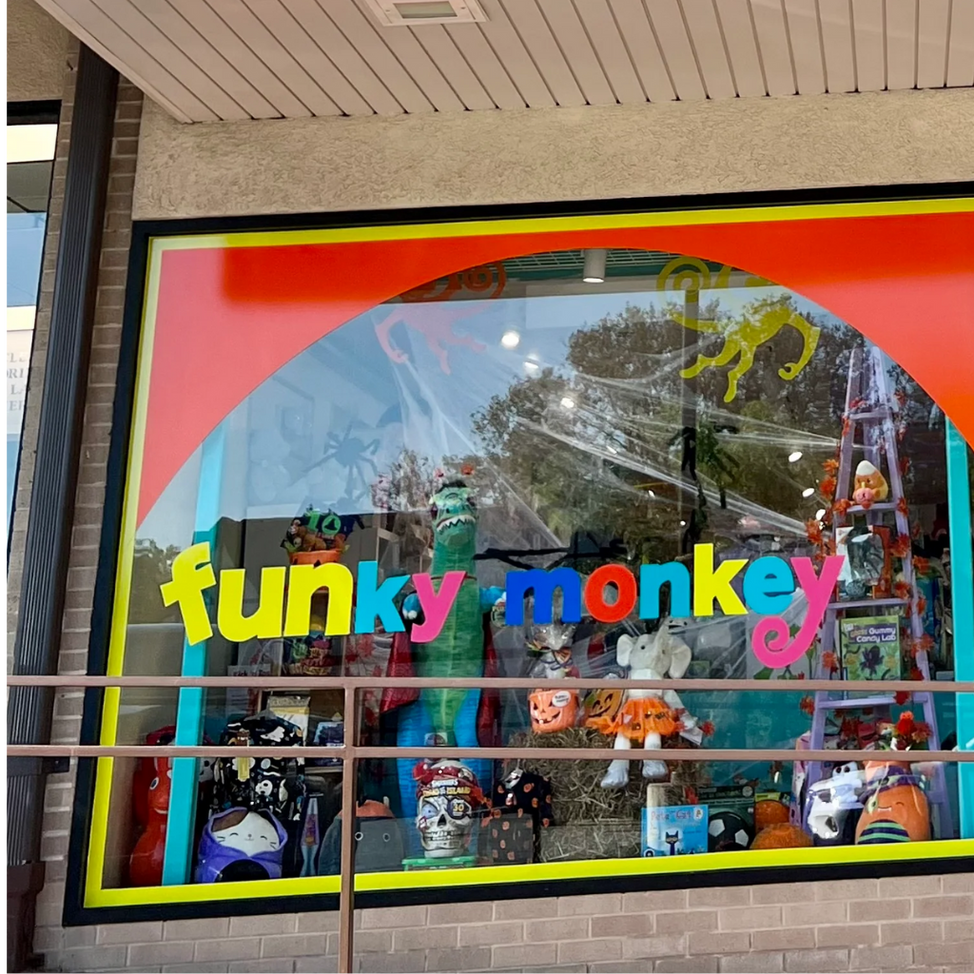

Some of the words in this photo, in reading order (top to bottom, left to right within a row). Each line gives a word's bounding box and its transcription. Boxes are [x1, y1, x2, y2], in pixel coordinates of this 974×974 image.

[160, 542, 467, 646] funky
[505, 543, 845, 670] monkey
[868, 627, 896, 635] Gummy
[856, 635, 880, 643] Candy
